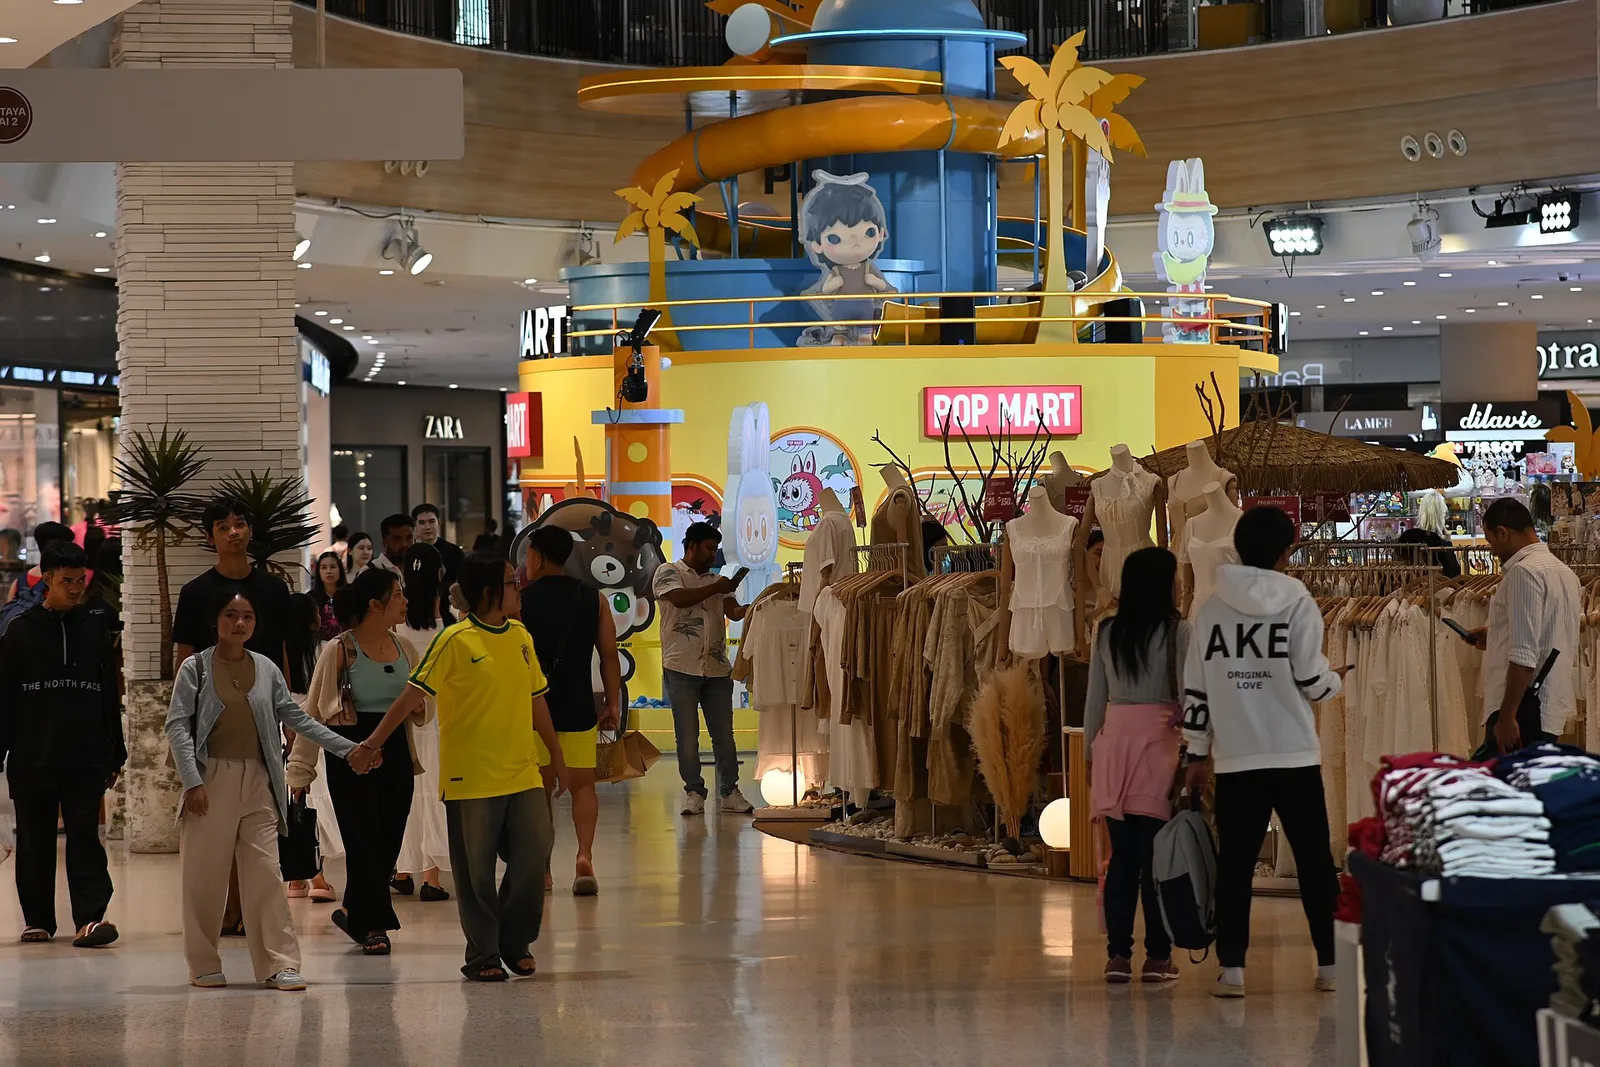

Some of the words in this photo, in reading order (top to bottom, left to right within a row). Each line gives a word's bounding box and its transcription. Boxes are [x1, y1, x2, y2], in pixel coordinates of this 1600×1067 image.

[11, 117, 19, 126] 2
[933, 393, 990, 429] POP
[998, 392, 1075, 427] MART
[1459, 403, 1542, 429] dilavie
[425, 415, 464, 439] ZARA
[1345, 416, 1363, 430] LA
[1364, 416, 1393, 430] MER
[1464, 441, 1525, 453] TISSOT
[1204, 623, 1290, 661] AKE
[1227, 670, 1273, 679] ORIGINAL
[22, 682, 41, 692] THE
[44, 679, 77, 688] NORTH
[80, 681, 101, 691] FACE
[1236, 682, 1263, 690] LOVE
